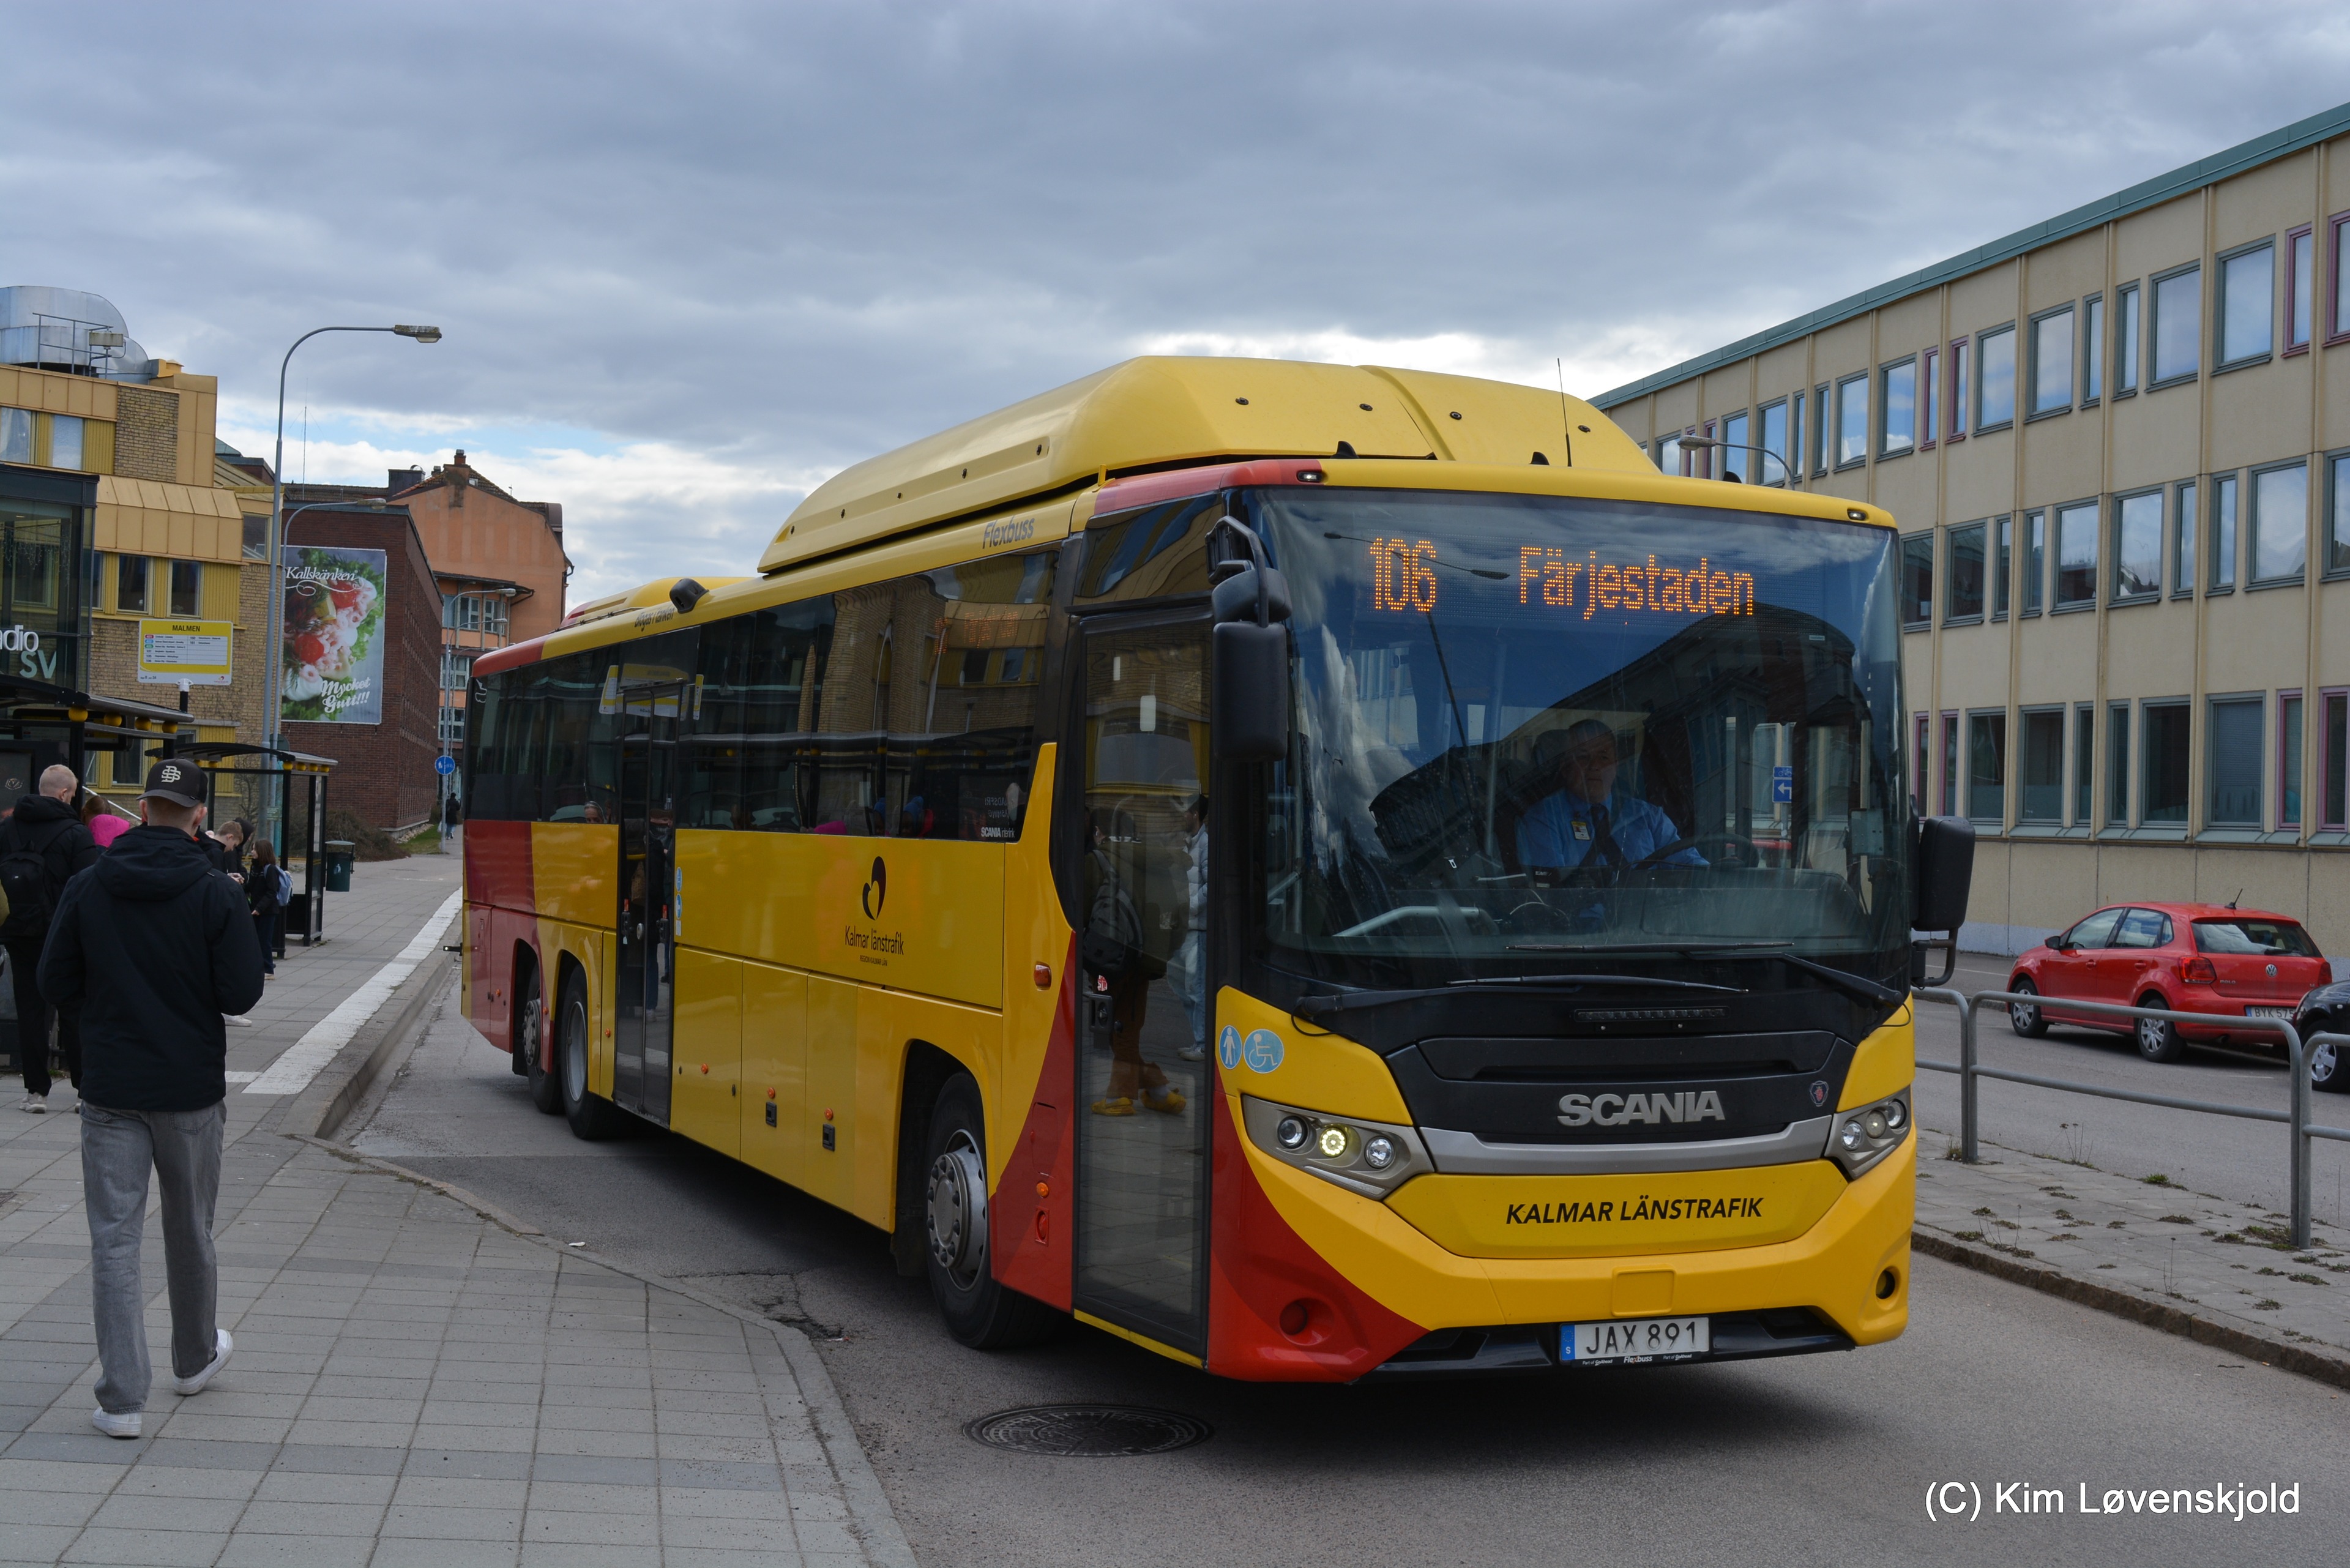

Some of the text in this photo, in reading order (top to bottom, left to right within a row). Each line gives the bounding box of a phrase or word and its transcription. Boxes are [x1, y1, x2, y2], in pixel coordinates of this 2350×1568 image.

[982, 516, 1035, 549] Flexbuss
[1370, 538, 1753, 619] 106 Färjestaden
[0, 625, 39, 652] dio
[321, 677, 371, 698] Mycket
[322, 691, 370, 713] Gutt!!!
[980, 827, 1001, 837] SCANIA
[845, 925, 904, 955] Kalmar länstrafik
[2255, 1008, 2275, 1018] BYK
[1557, 1091, 1726, 1127] SCANIA
[1506, 1195, 1764, 1225] KALMAR LÄNSTRAFIK
[1586, 1321, 1695, 1354] JAX 891
